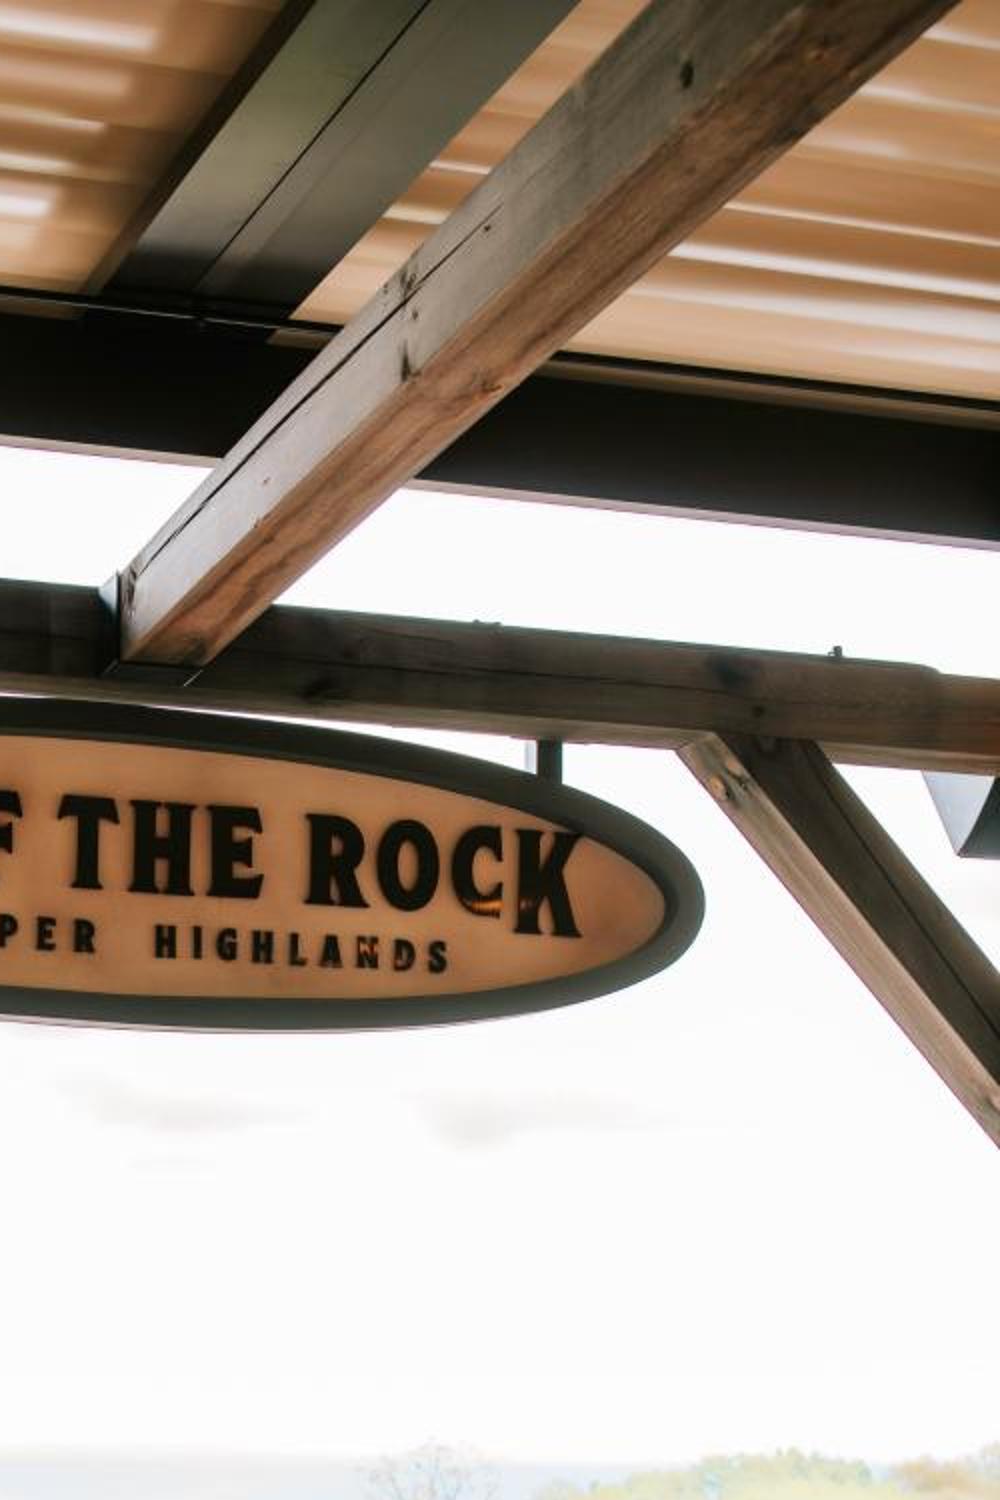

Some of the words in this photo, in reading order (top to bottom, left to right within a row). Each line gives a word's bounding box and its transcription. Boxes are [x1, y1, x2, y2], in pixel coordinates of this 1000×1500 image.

[56, 794, 265, 899] THE
[302, 812, 583, 939] ROCK
[153, 923, 449, 974] HIGHLANDS
